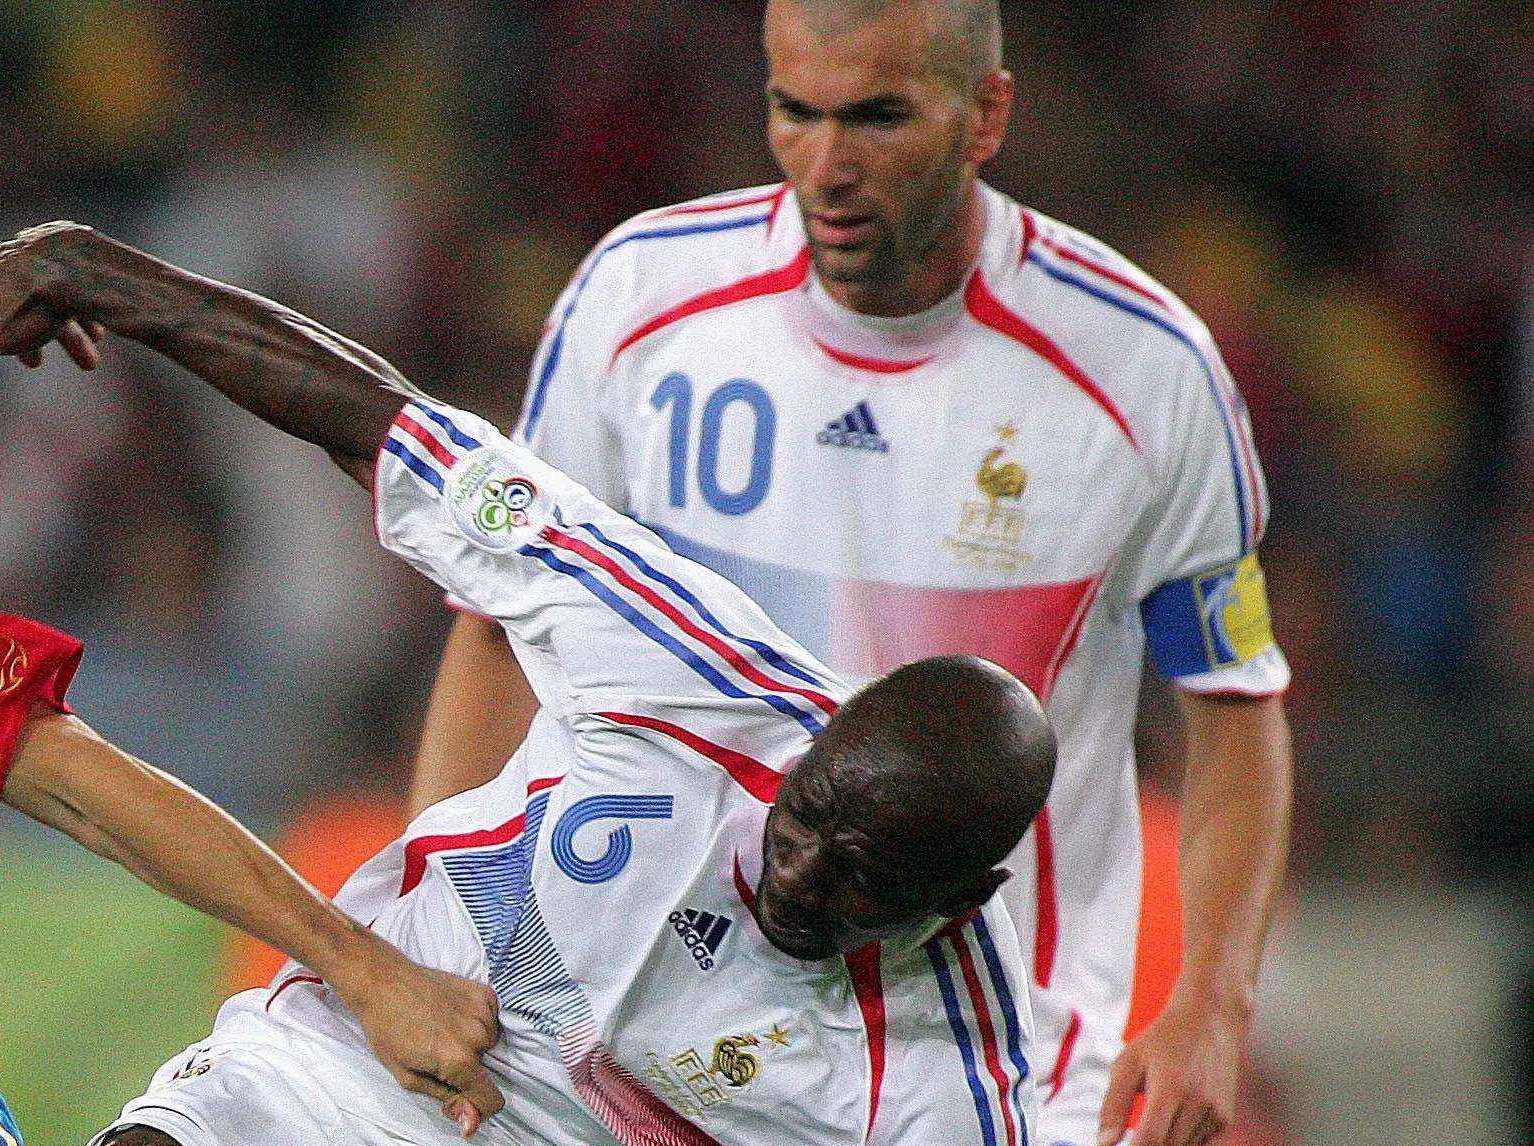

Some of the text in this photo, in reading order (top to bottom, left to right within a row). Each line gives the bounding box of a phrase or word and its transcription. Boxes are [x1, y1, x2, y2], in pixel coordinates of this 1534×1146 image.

[650, 371, 776, 516] 10
[551, 794, 674, 884] 6
[668, 909, 714, 971] adidas
